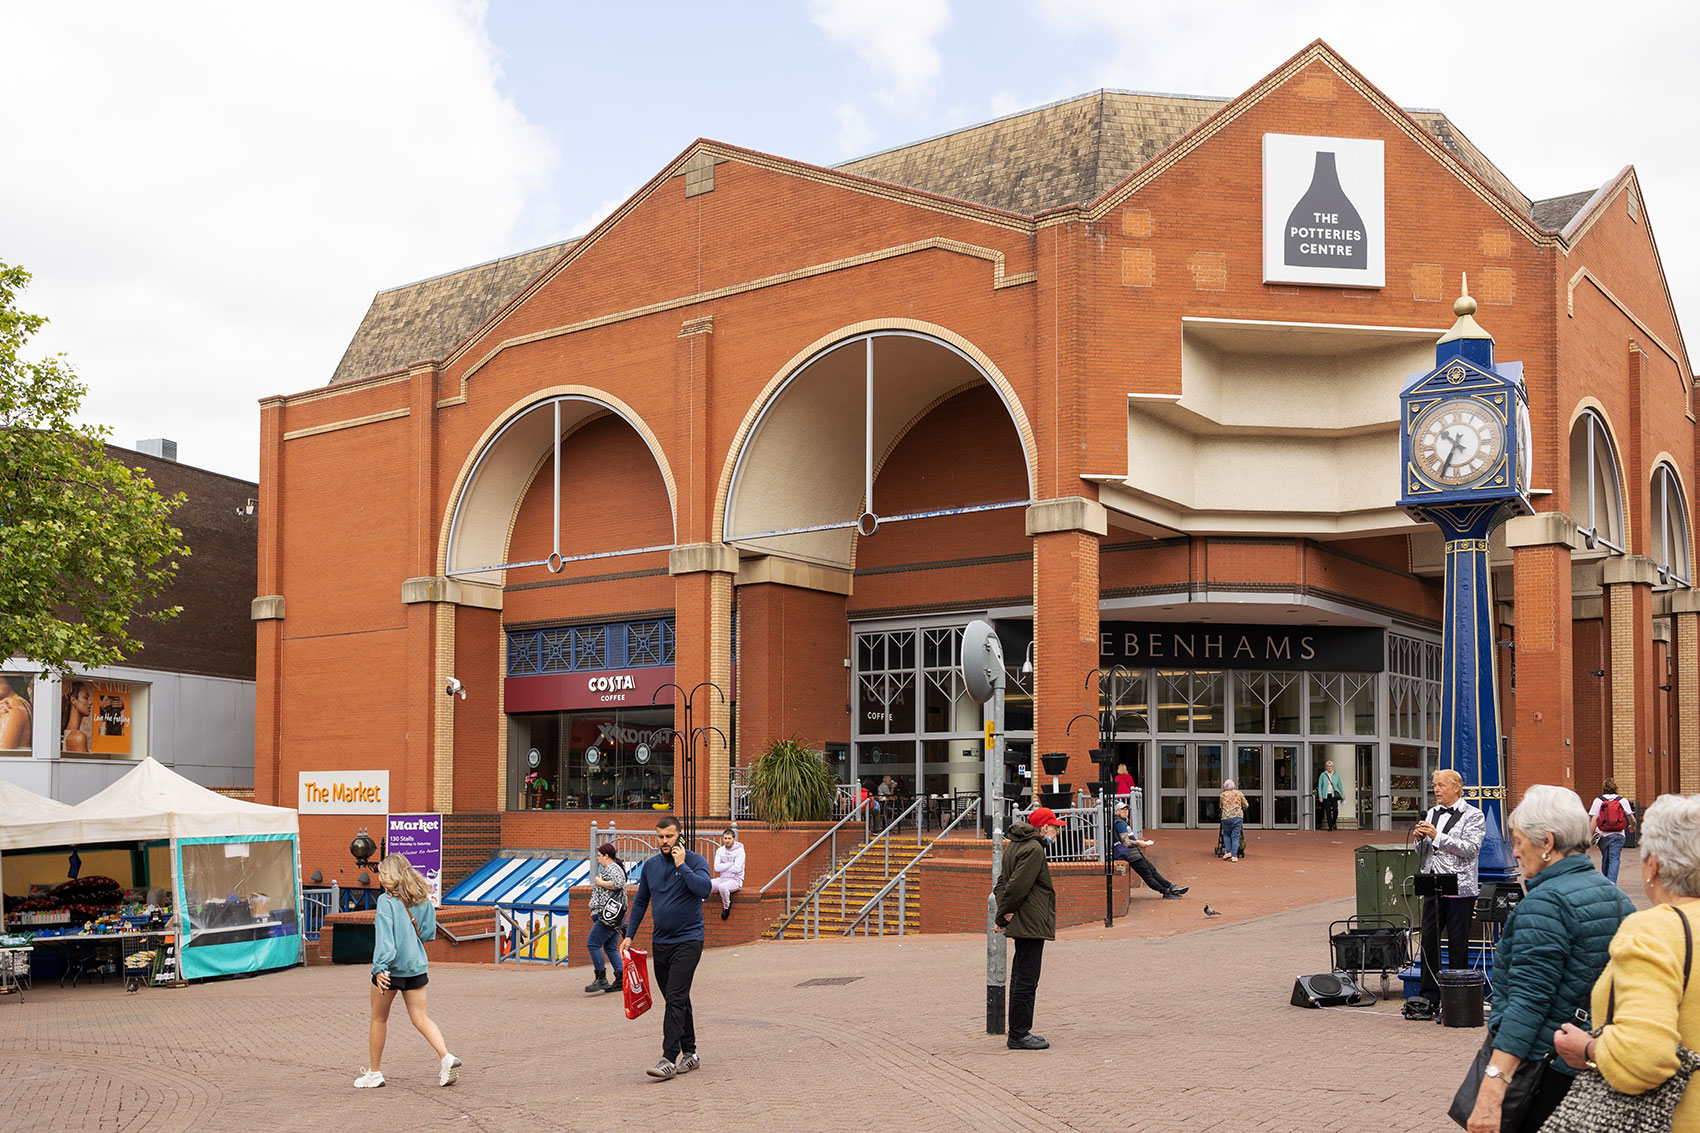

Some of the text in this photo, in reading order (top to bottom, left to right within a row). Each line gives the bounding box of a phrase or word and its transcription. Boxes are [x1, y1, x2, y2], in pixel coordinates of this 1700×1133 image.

[1313, 212, 1339, 224] THE
[1290, 227, 1361, 241] POTTERIES
[1299, 243, 1353, 256] CENTRE
[1099, 632, 1316, 660] EBENHAMS
[588, 675, 636, 692] COSTA
[600, 694, 626, 702] COFFEE
[867, 711, 893, 721] COFFE
[304, 780, 381, 803] The Market
[390, 819, 439, 832] Market
